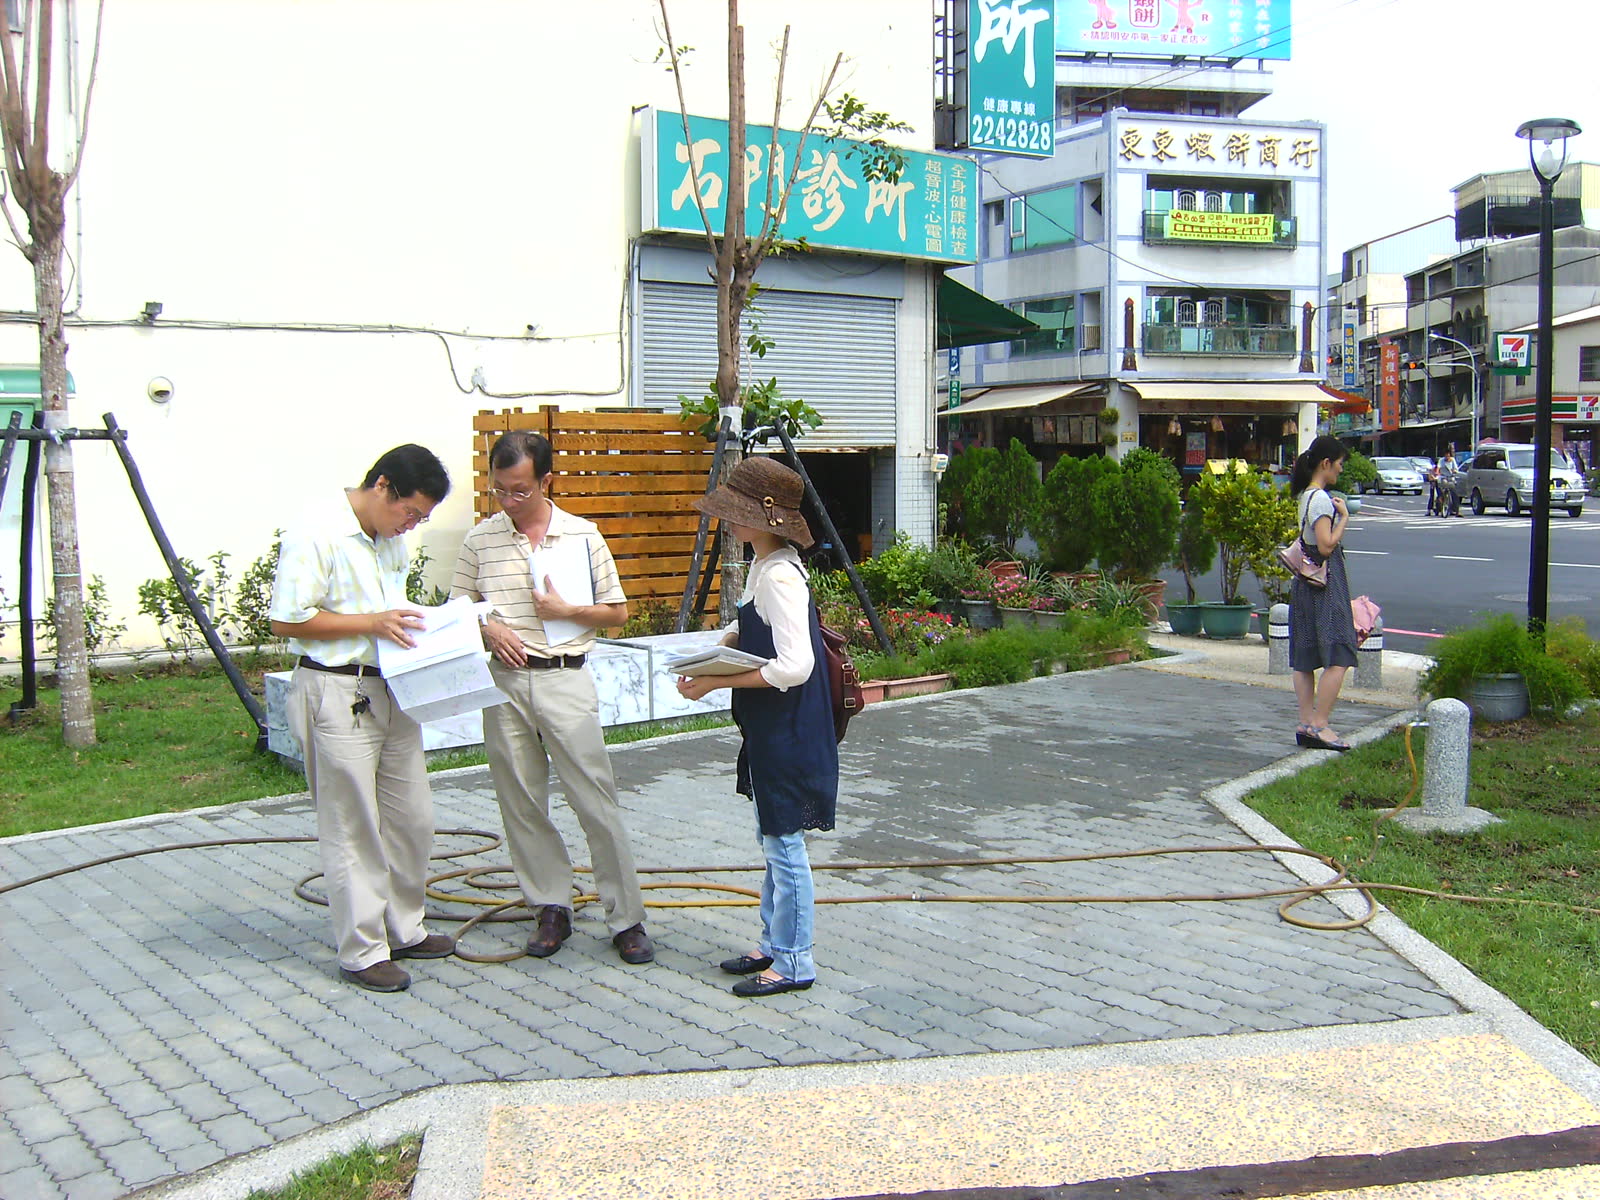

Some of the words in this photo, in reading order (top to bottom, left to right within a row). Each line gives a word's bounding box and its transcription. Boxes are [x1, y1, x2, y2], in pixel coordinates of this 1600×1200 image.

[983, 96, 1036, 117] 健康專線
[972, 114, 1051, 151] 2242828
[1119, 127, 1320, 168] 東東蝦餅商行
[672, 138, 915, 242] 石門診所
[950, 163, 968, 257] 全身健康檢查
